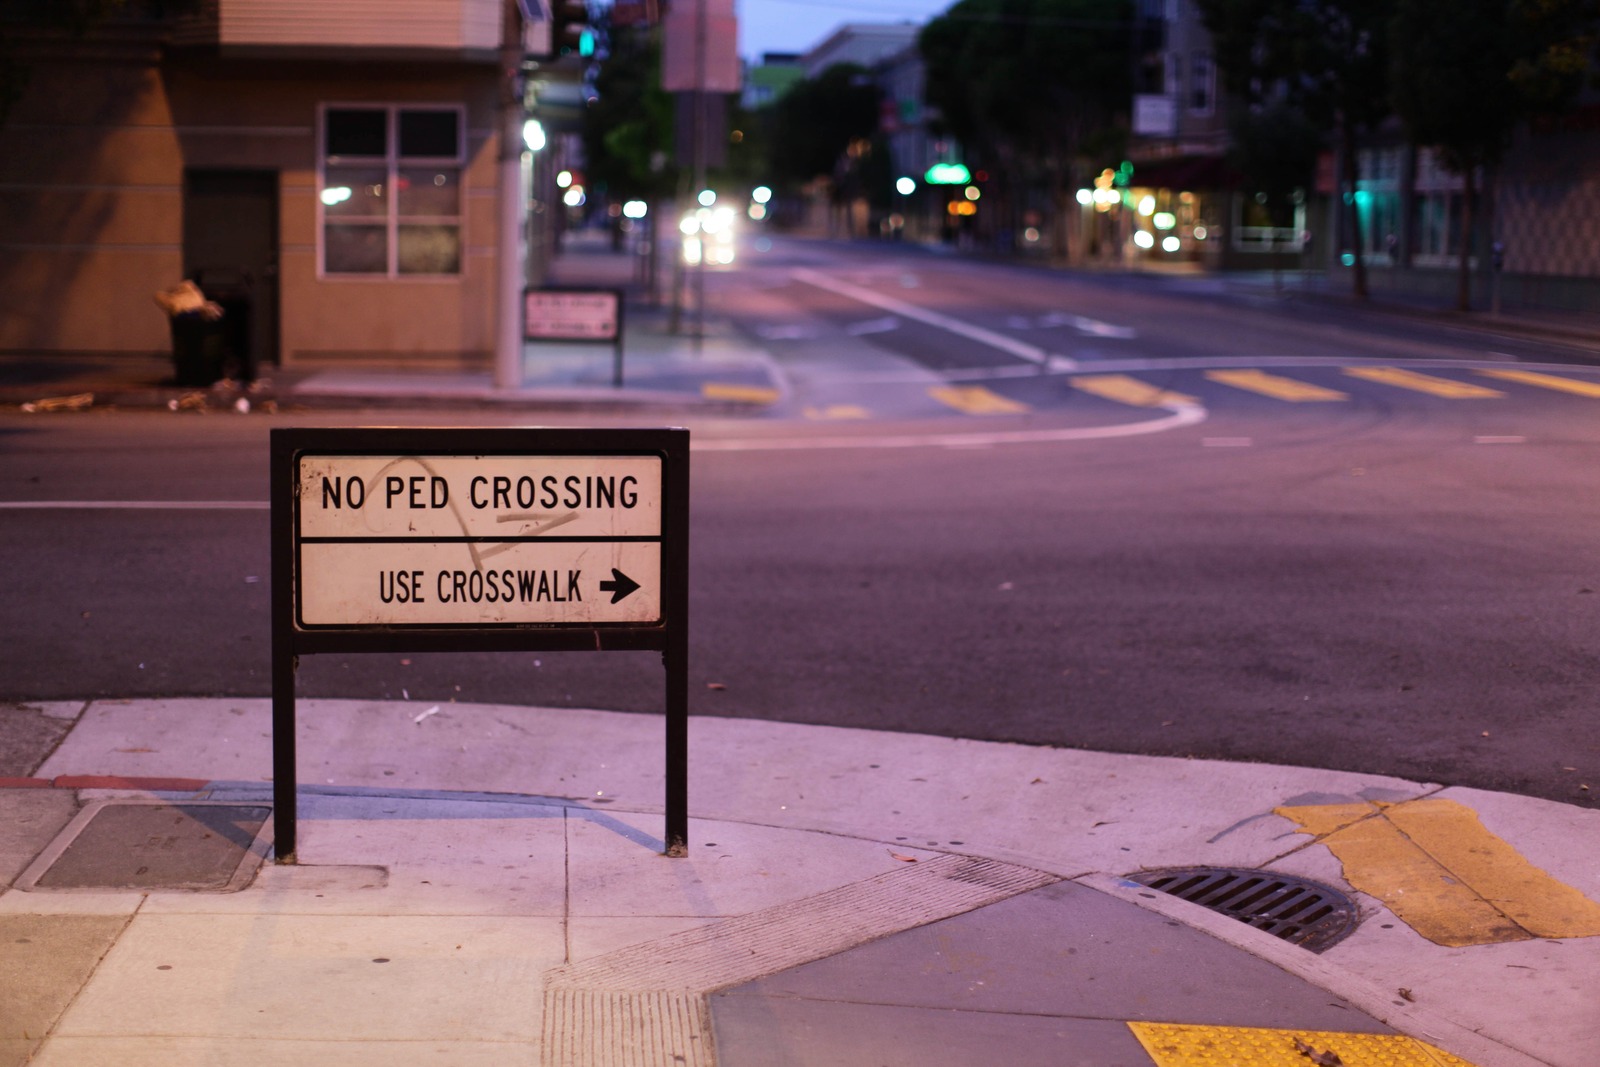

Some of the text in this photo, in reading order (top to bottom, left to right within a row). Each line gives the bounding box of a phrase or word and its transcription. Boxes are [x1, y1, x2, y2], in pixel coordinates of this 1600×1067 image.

[322, 475, 638, 510] NO PED CROSSING
[380, 569, 583, 604] USE CROSSWALK
